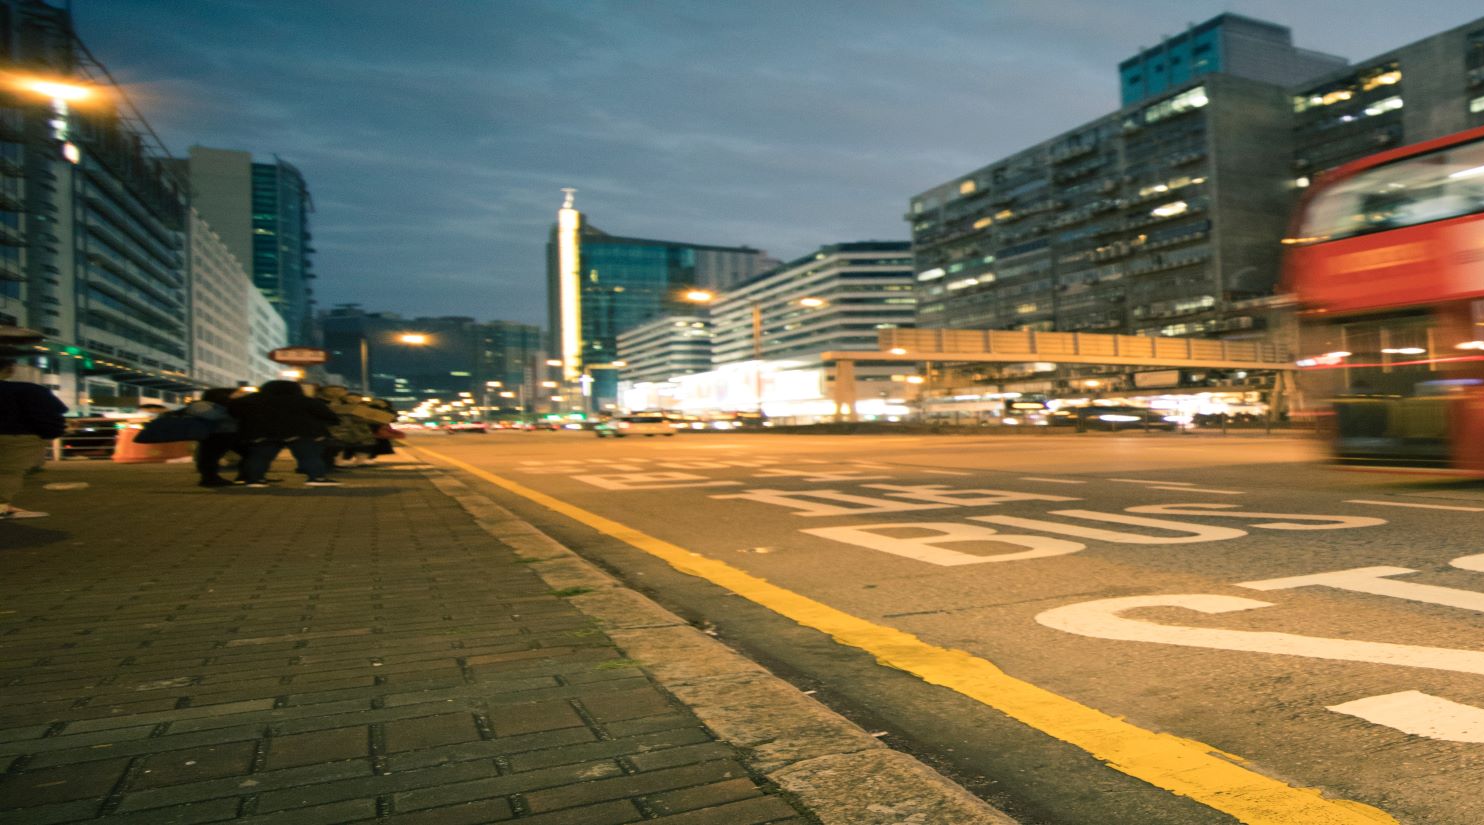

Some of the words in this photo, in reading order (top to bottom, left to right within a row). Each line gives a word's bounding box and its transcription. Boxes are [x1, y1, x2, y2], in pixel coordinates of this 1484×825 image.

[569, 468, 894, 490] 巴士
[708, 484, 1086, 517] 站
[799, 503, 1389, 567] BUS
